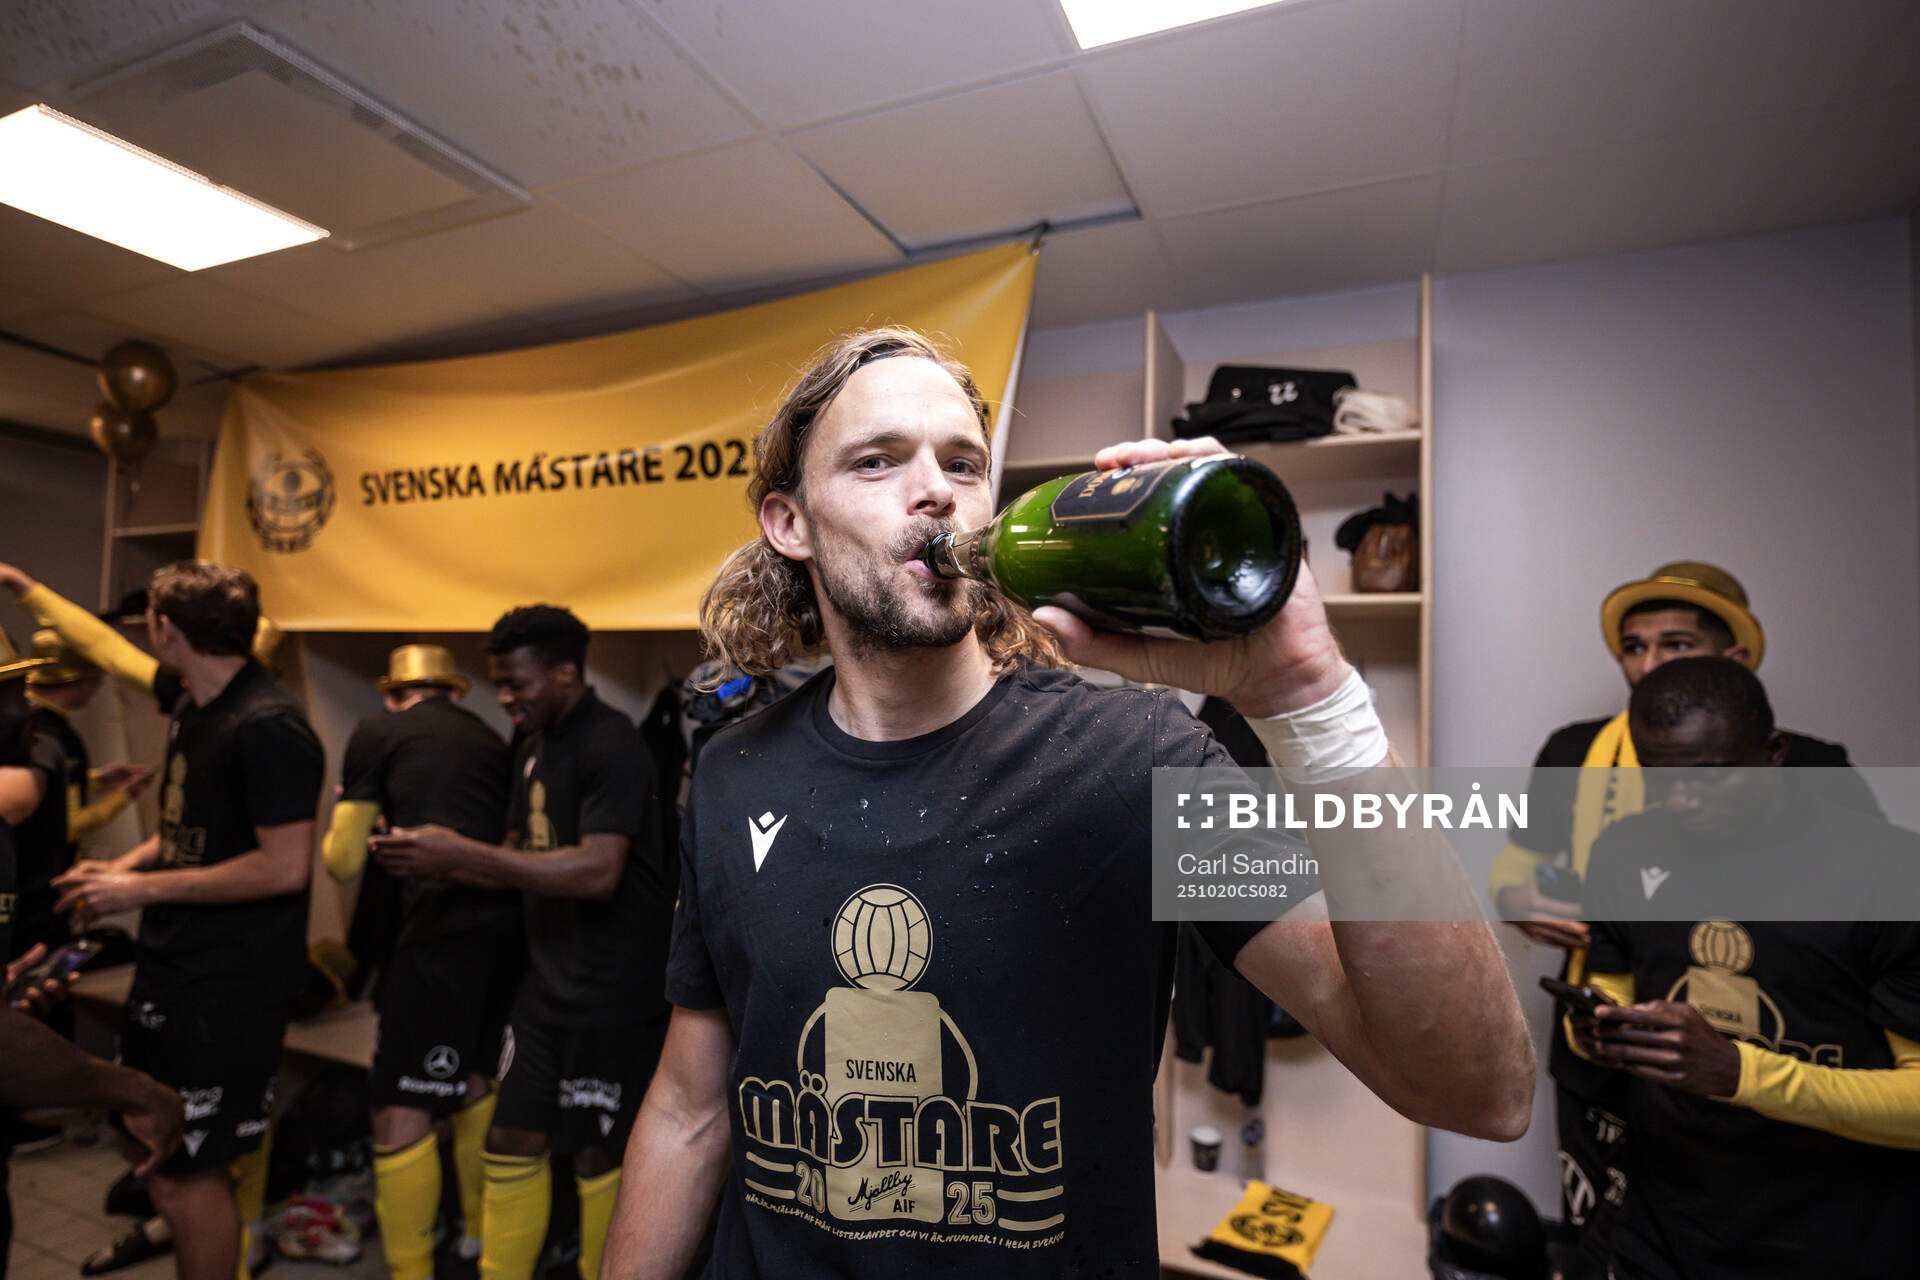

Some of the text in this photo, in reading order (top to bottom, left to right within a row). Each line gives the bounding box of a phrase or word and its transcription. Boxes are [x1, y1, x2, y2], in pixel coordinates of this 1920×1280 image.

[361, 464, 486, 506] SVENSKA
[494, 448, 664, 493] MÄSTARE
[674, 438, 757, 481] 202
[846, 1059, 917, 1083] SVENSKA
[738, 1069, 1064, 1176] MÄSTARE
[795, 1160, 826, 1214] 20
[848, 1170, 913, 1211] Mjällby
[893, 1198, 916, 1213] AIF
[946, 1181, 997, 1226] 25
[832, 1227, 899, 1241] LISTERLANDET
[899, 1228, 917, 1240] OCH
[918, 1231, 928, 1241] VI
[930, 1231, 945, 1243] ÄR
[945, 1233, 991, 1245] NUMMER
[1005, 1238, 1030, 1249] HELA
